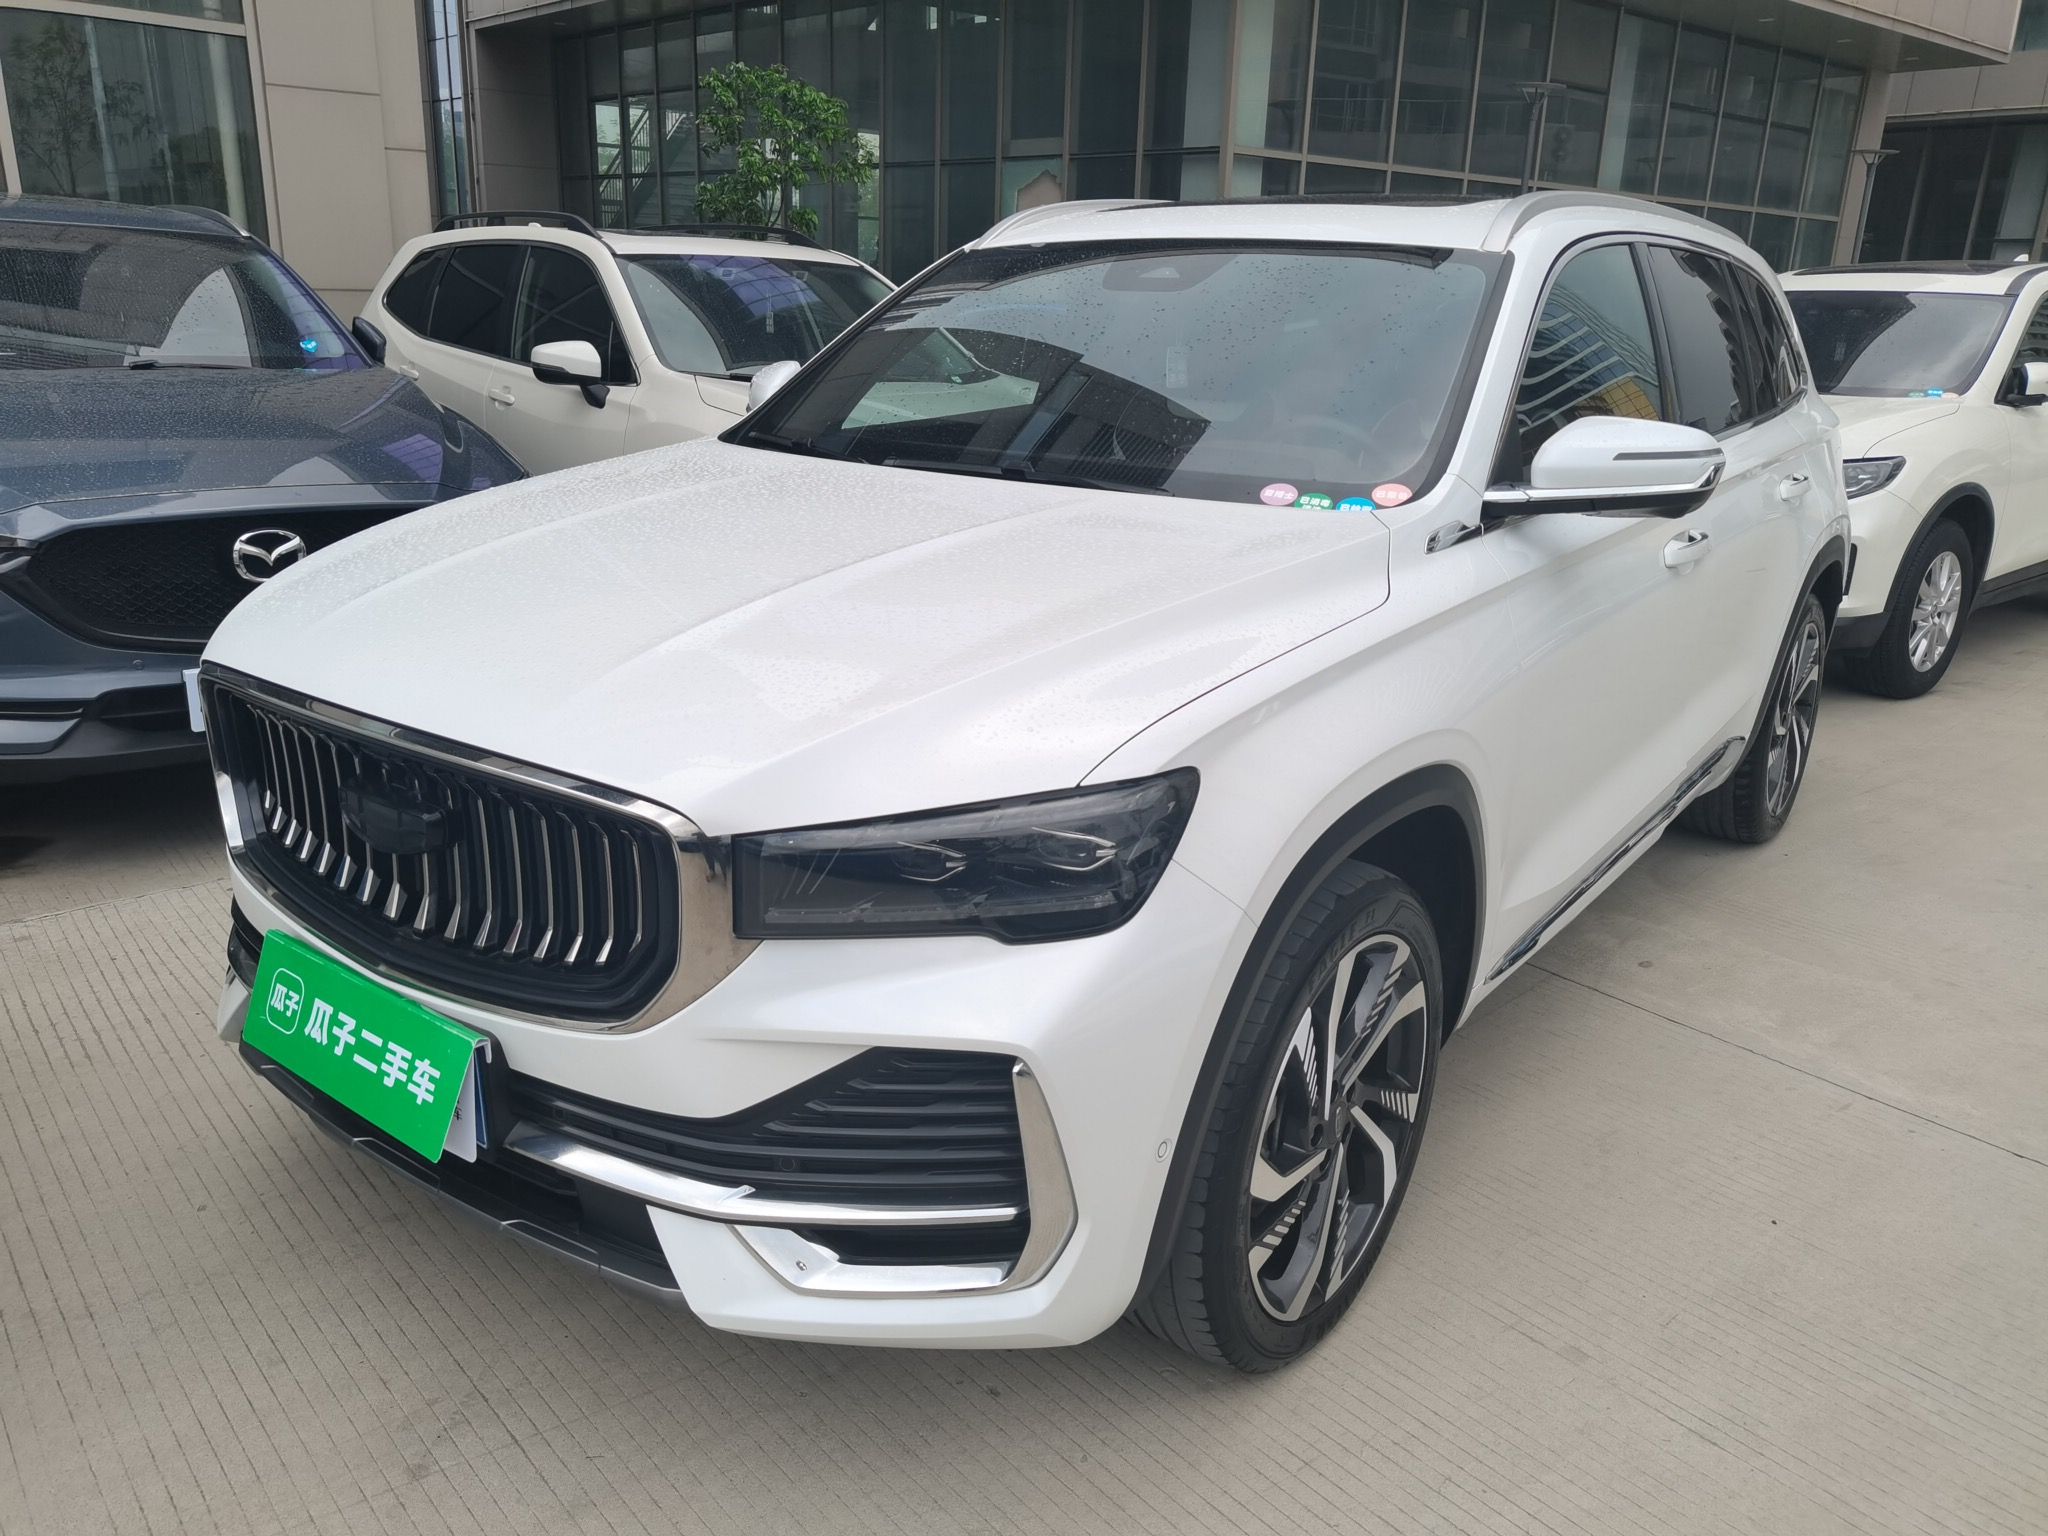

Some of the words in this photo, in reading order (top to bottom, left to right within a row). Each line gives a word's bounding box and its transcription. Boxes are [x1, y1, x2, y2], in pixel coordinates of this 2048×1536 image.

[271, 983, 299, 1017] 瓜子
[304, 998, 441, 1105] 瓜子二手车
